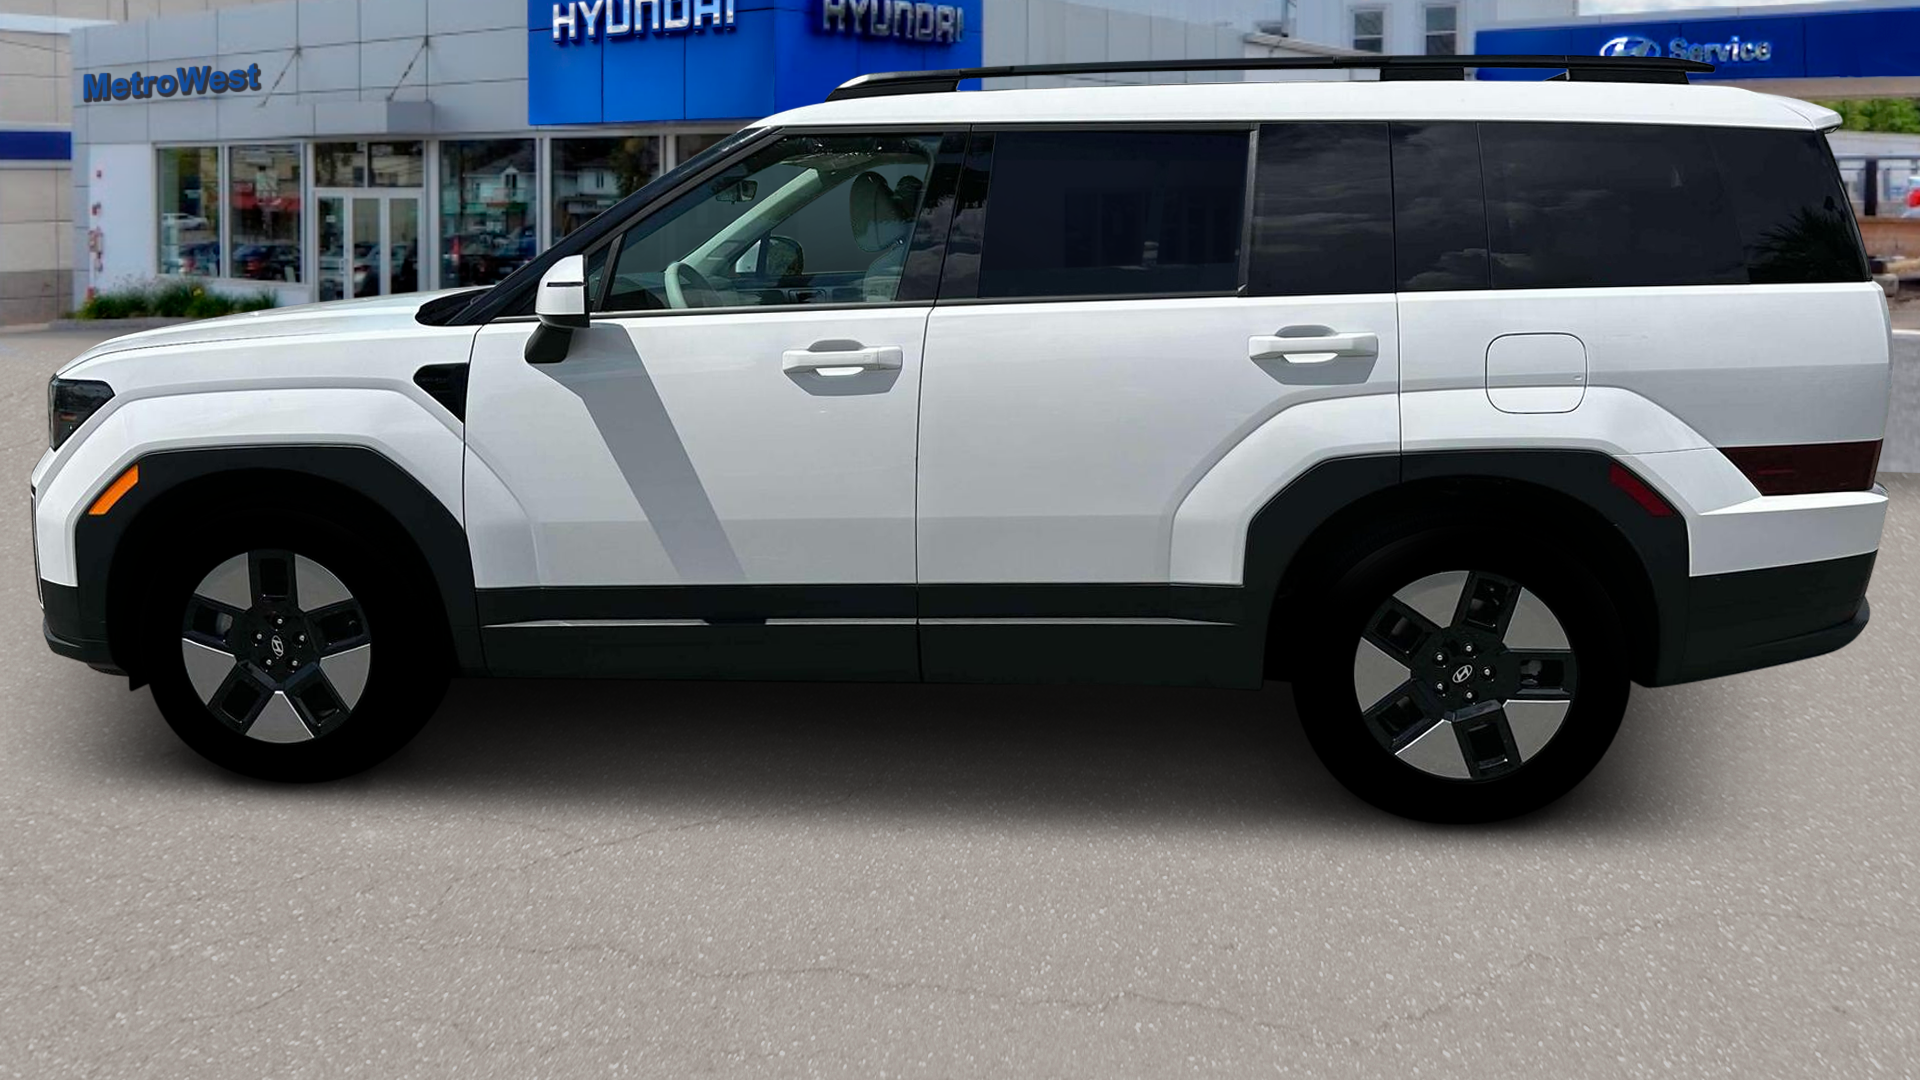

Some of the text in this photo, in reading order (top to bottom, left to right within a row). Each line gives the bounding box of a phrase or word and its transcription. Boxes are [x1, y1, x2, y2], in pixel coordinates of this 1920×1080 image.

[552, 0, 736, 43] HYUNDAI
[821, 0, 964, 43] HYUNDAI
[1668, 35, 1772, 62] Service
[83, 63, 261, 102] MetroWest
